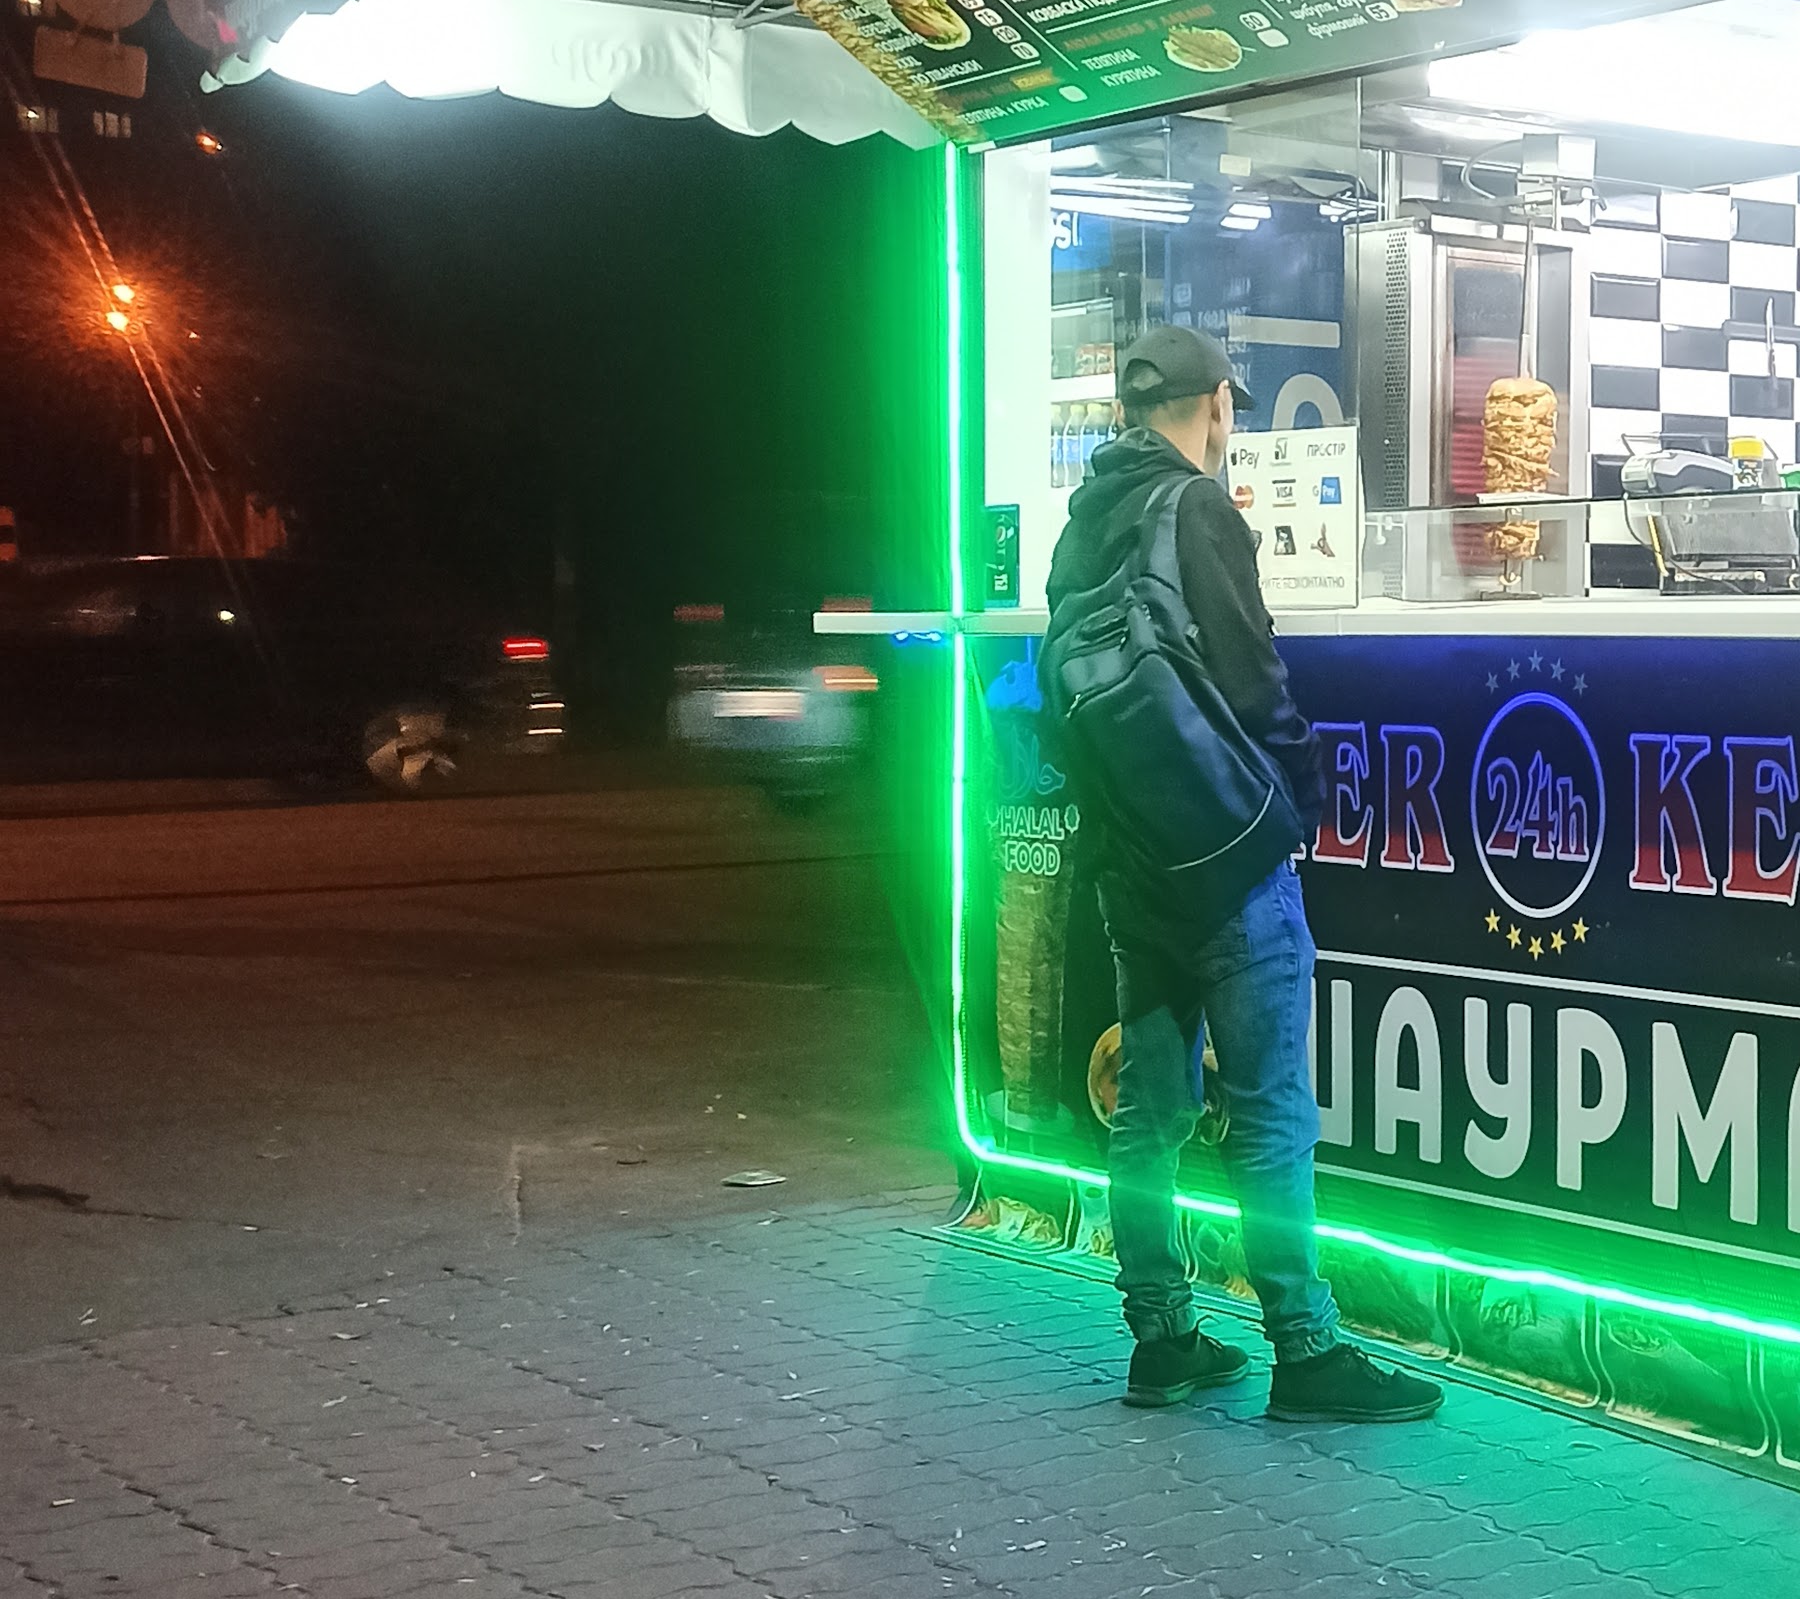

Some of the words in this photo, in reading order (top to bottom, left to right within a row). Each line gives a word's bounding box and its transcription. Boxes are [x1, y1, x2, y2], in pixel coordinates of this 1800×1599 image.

[977, 12, 1000, 25] 75
[1368, 4, 1390, 19] 55
[995, 27, 1017, 41] 120
[1013, 45, 1033, 57] 70
[1240, 448, 1260, 469] Pay
[1275, 486, 1293, 498] VISA
[1486, 750, 1590, 862] 24h
[1001, 805, 1065, 840] HALAL
[1005, 840, 1061, 876] FOOD
